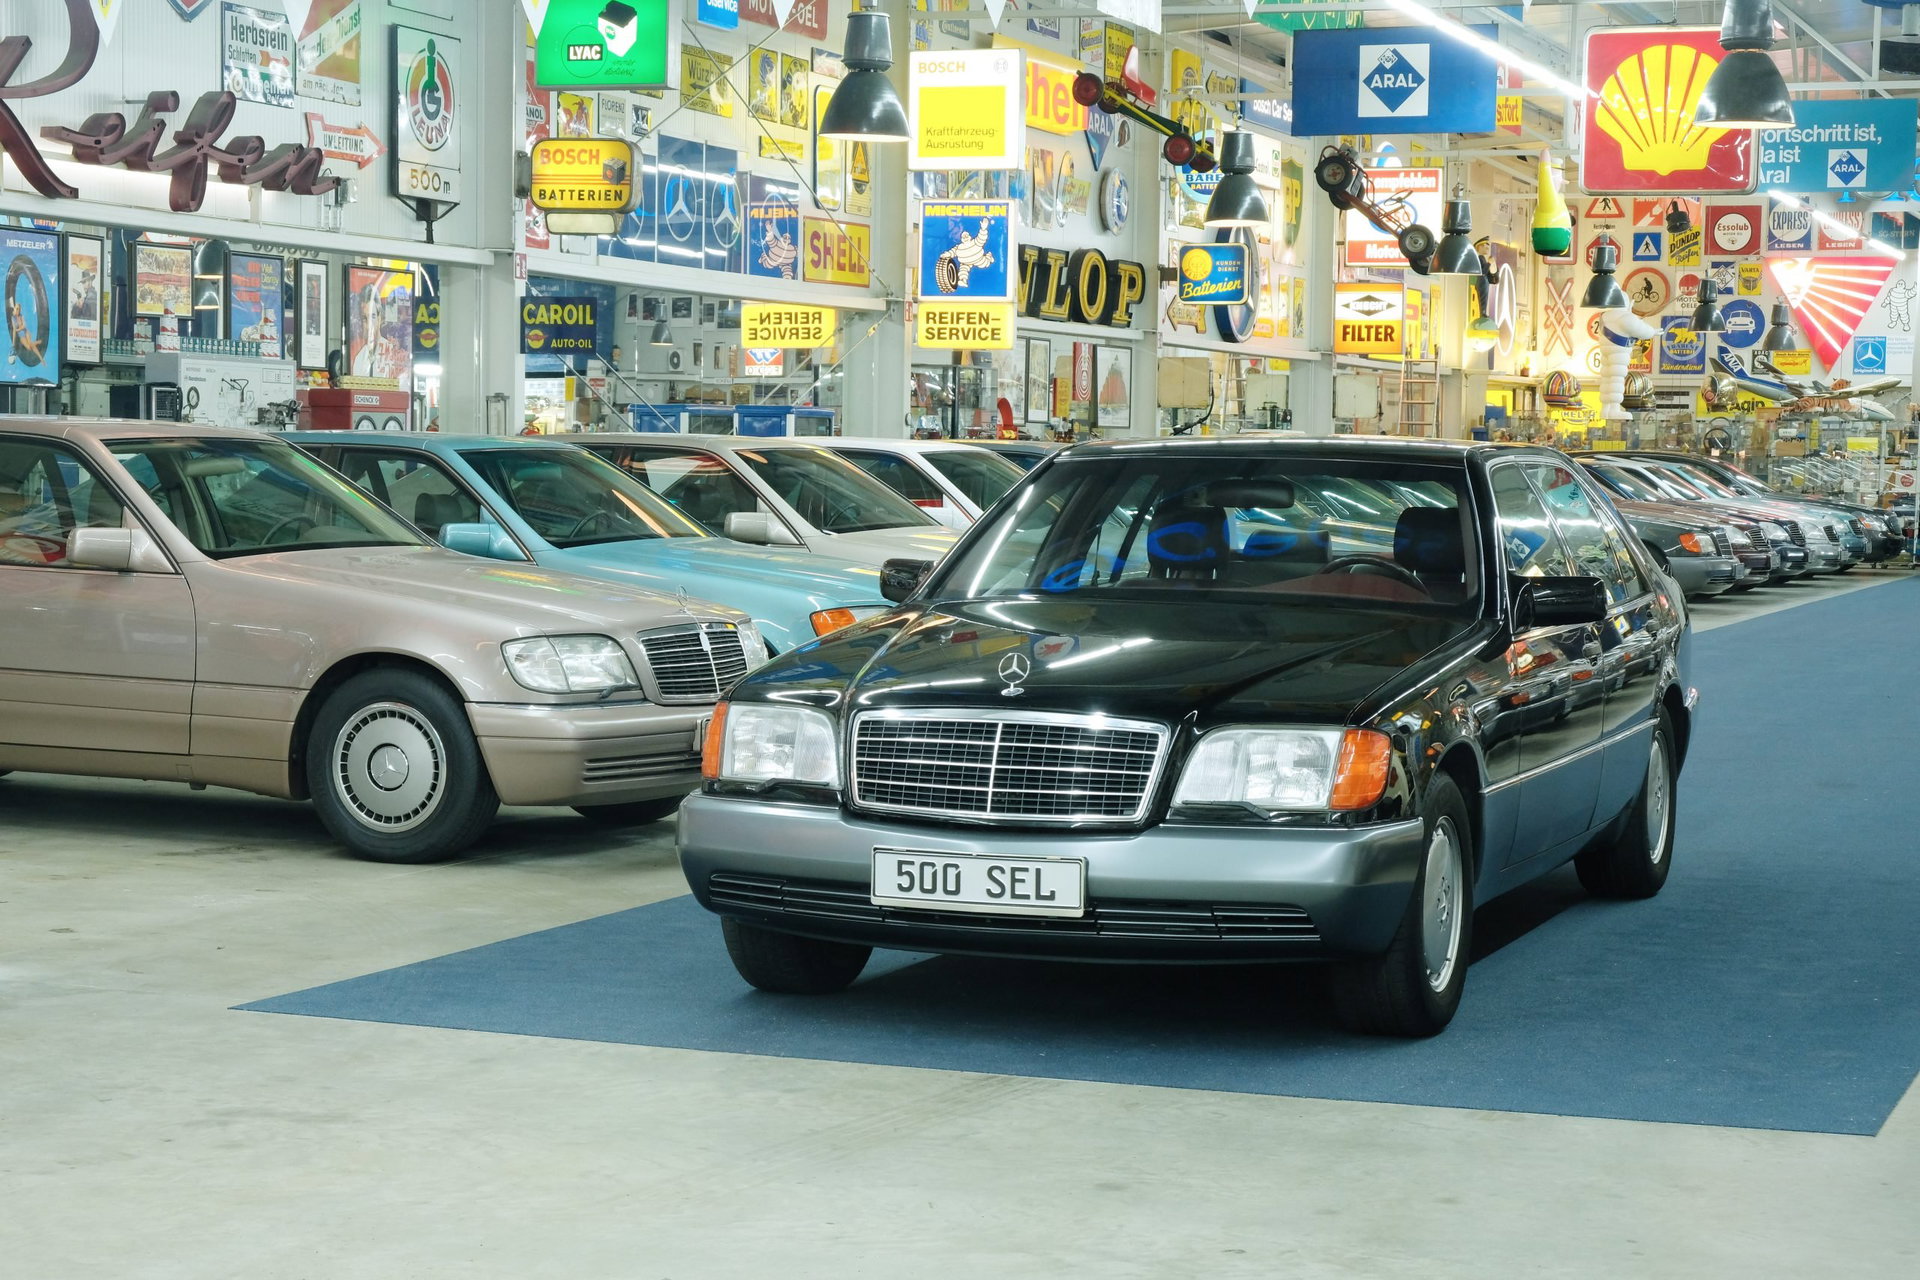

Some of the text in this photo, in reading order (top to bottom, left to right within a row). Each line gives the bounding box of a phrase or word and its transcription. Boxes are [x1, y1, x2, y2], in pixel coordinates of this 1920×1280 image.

[230, 15, 288, 51] Herbstein
[569, 45, 601, 60] LYAC
[918, 61, 966, 73] BOSCH
[1370, 73, 1418, 89] ARAL
[601, 98, 626, 114] FLORENZ
[411, 107, 450, 145] LEUNA
[1089, 112, 1111, 136] ARAL
[1760, 123, 1882, 144] ortschritt ist,
[323, 133, 364, 153] UMLEITUNG
[540, 148, 600, 165] BOSCH
[1779, 145, 1801, 163] ist
[1186, 173, 1224, 182] BARE
[1834, 165, 1861, 173] ARAL
[410, 168, 441, 192] 500
[538, 189, 624, 201] BATTERIEN
[925, 205, 1007, 216] MICHELIN
[1717, 223, 1749, 231] Essolub
[1772, 211, 1809, 230] EXPRESS
[7, 238, 46, 250] METZELER
[1670, 231, 1700, 254] DUNLOP
[810, 230, 865, 274] SHELL
[1181, 278, 1241, 299] Batterien
[522, 303, 594, 325] CAROIL
[925, 312, 1001, 325] REIFEN-
[925, 327, 1002, 341] SERVICE
[1342, 324, 1395, 343] FILTER
[1721, 352, 1741, 373] ANA
[897, 860, 1056, 901] 500 SEL
